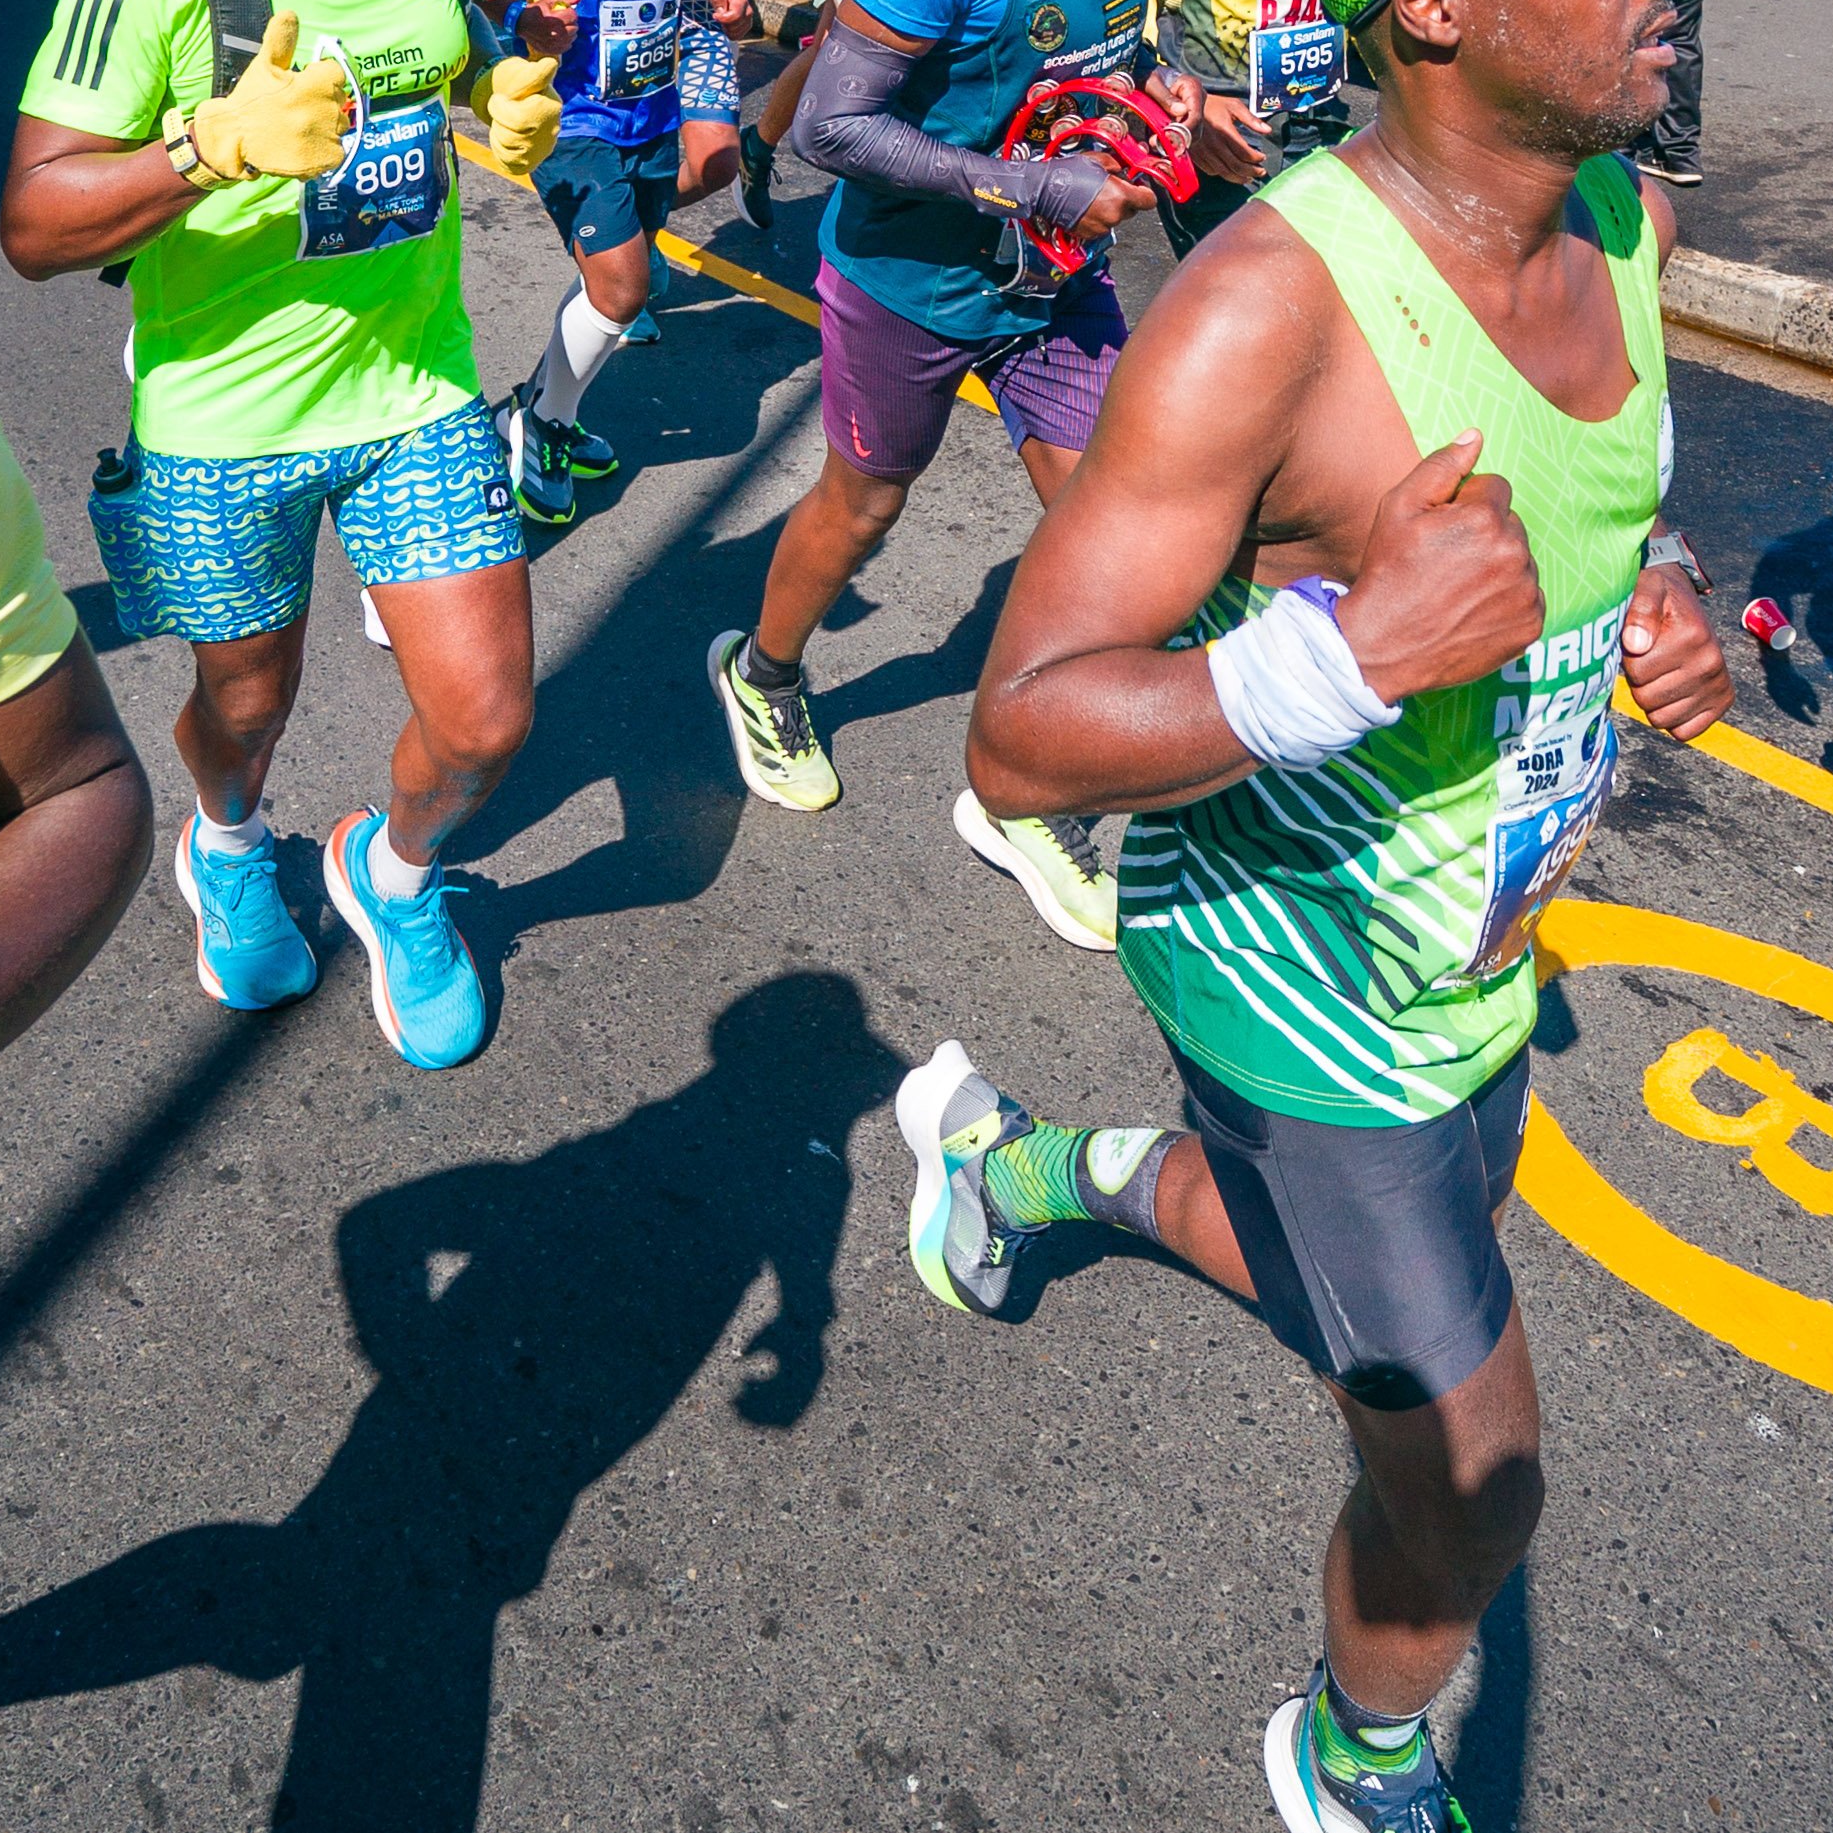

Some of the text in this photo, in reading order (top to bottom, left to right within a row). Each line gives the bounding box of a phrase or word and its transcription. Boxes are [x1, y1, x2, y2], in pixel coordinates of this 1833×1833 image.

[1293, 26, 1336, 47] Sanlam
[625, 39, 674, 73] 5065
[1280, 42, 1334, 76] 5795
[1262, 96, 1281, 106] ASA
[362, 119, 429, 150] Sanlam
[355, 147, 426, 196] 809
[319, 232, 345, 245] ASA
[1517, 747, 1564, 772] BORA
[1524, 771, 1560, 796] 2024
